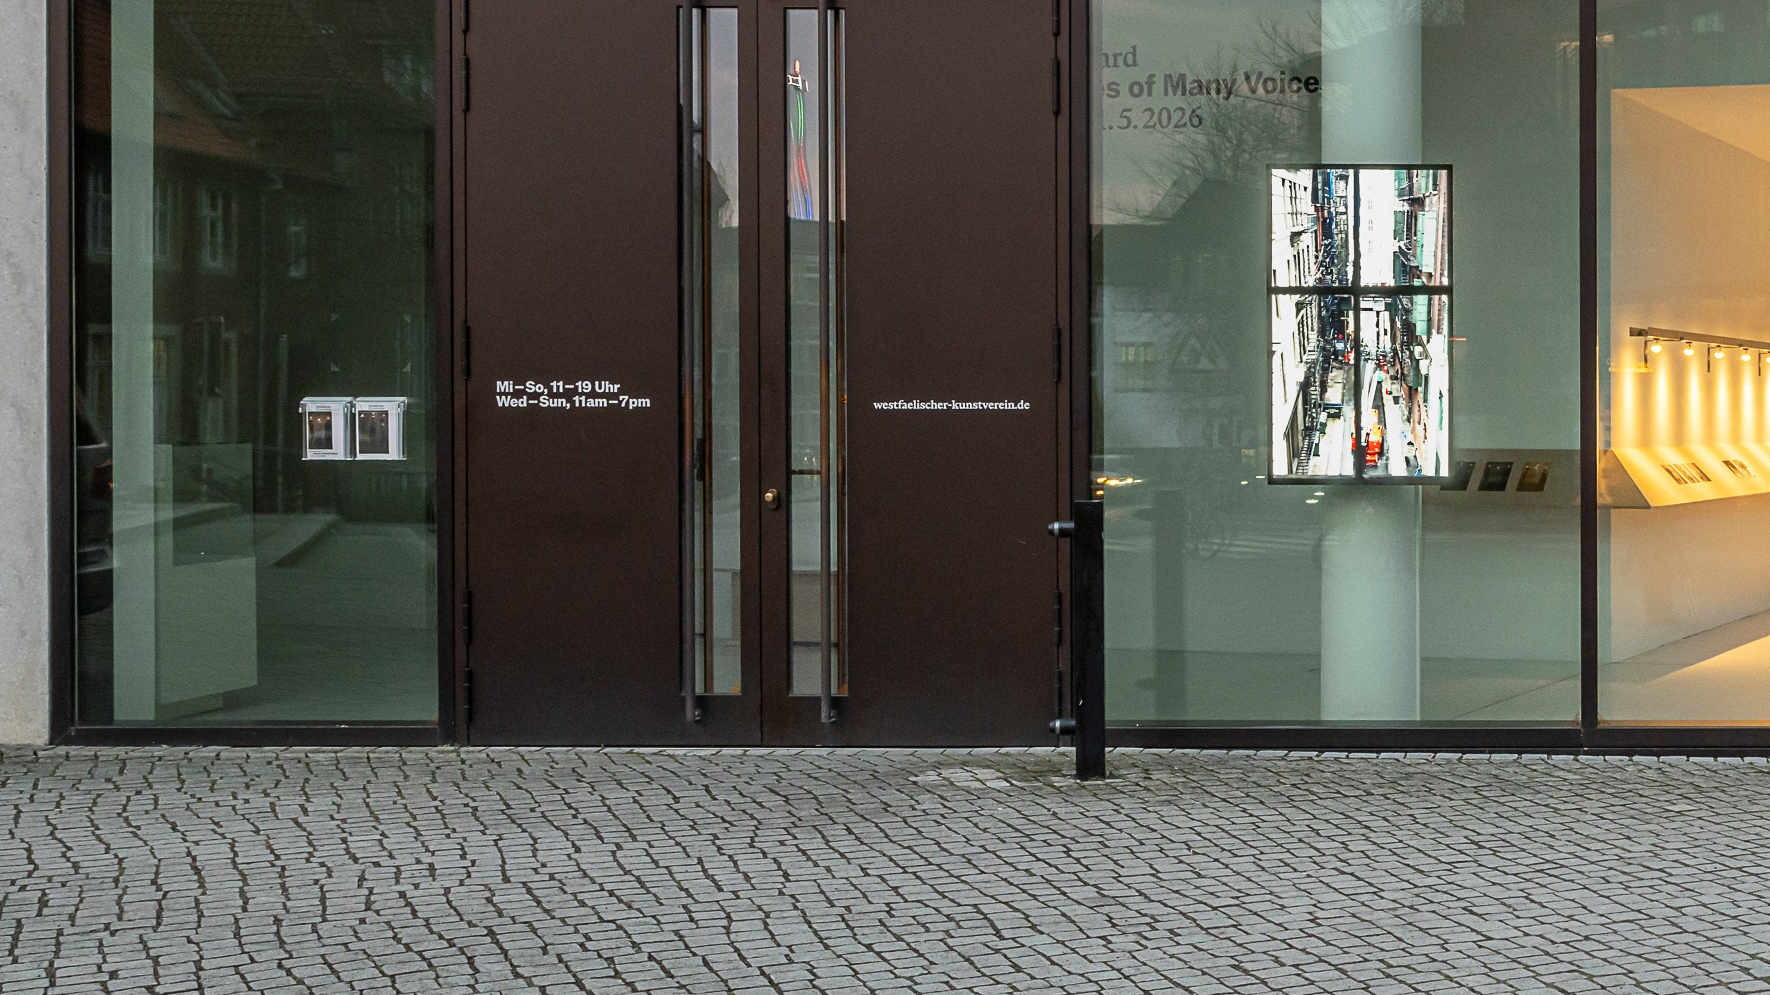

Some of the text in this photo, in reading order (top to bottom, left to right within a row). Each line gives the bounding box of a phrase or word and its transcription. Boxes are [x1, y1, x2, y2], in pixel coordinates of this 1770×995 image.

[1128, 74, 1156, 98] of
[1163, 72, 1238, 101] Many
[1244, 70, 1323, 94] Voice
[594, 381, 620, 393] Uhr
[873, 400, 1031, 410] westfaelischer-kunstverein.de
